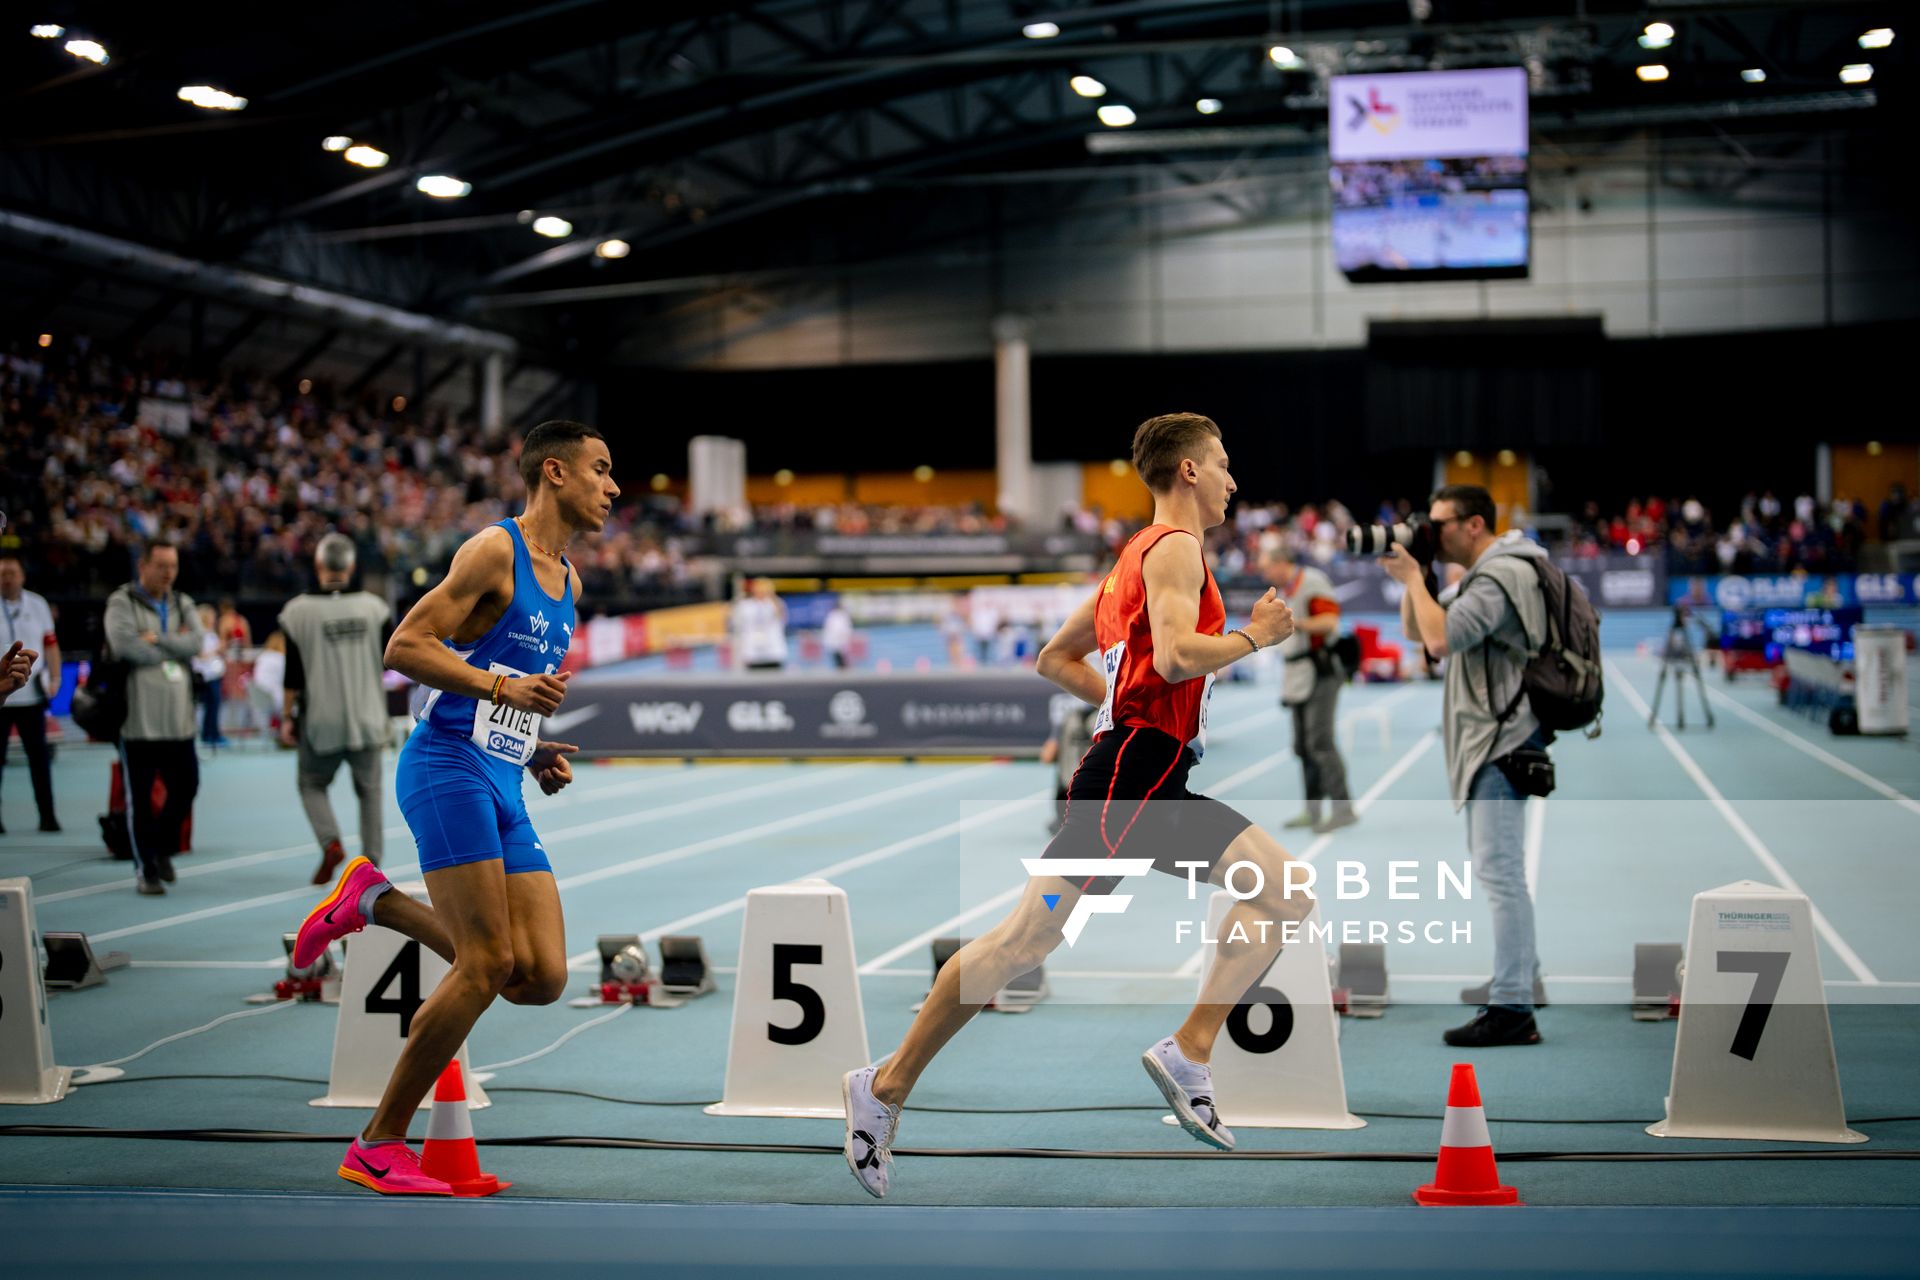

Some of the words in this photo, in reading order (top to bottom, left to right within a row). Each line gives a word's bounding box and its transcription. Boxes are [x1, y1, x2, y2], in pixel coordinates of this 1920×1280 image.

[504, 739, 524, 753] PLAN
[365, 940, 426, 1038] 4
[767, 943, 825, 1045] 5
[1227, 948, 1294, 1054] 6
[1716, 951, 1791, 1061] 7
